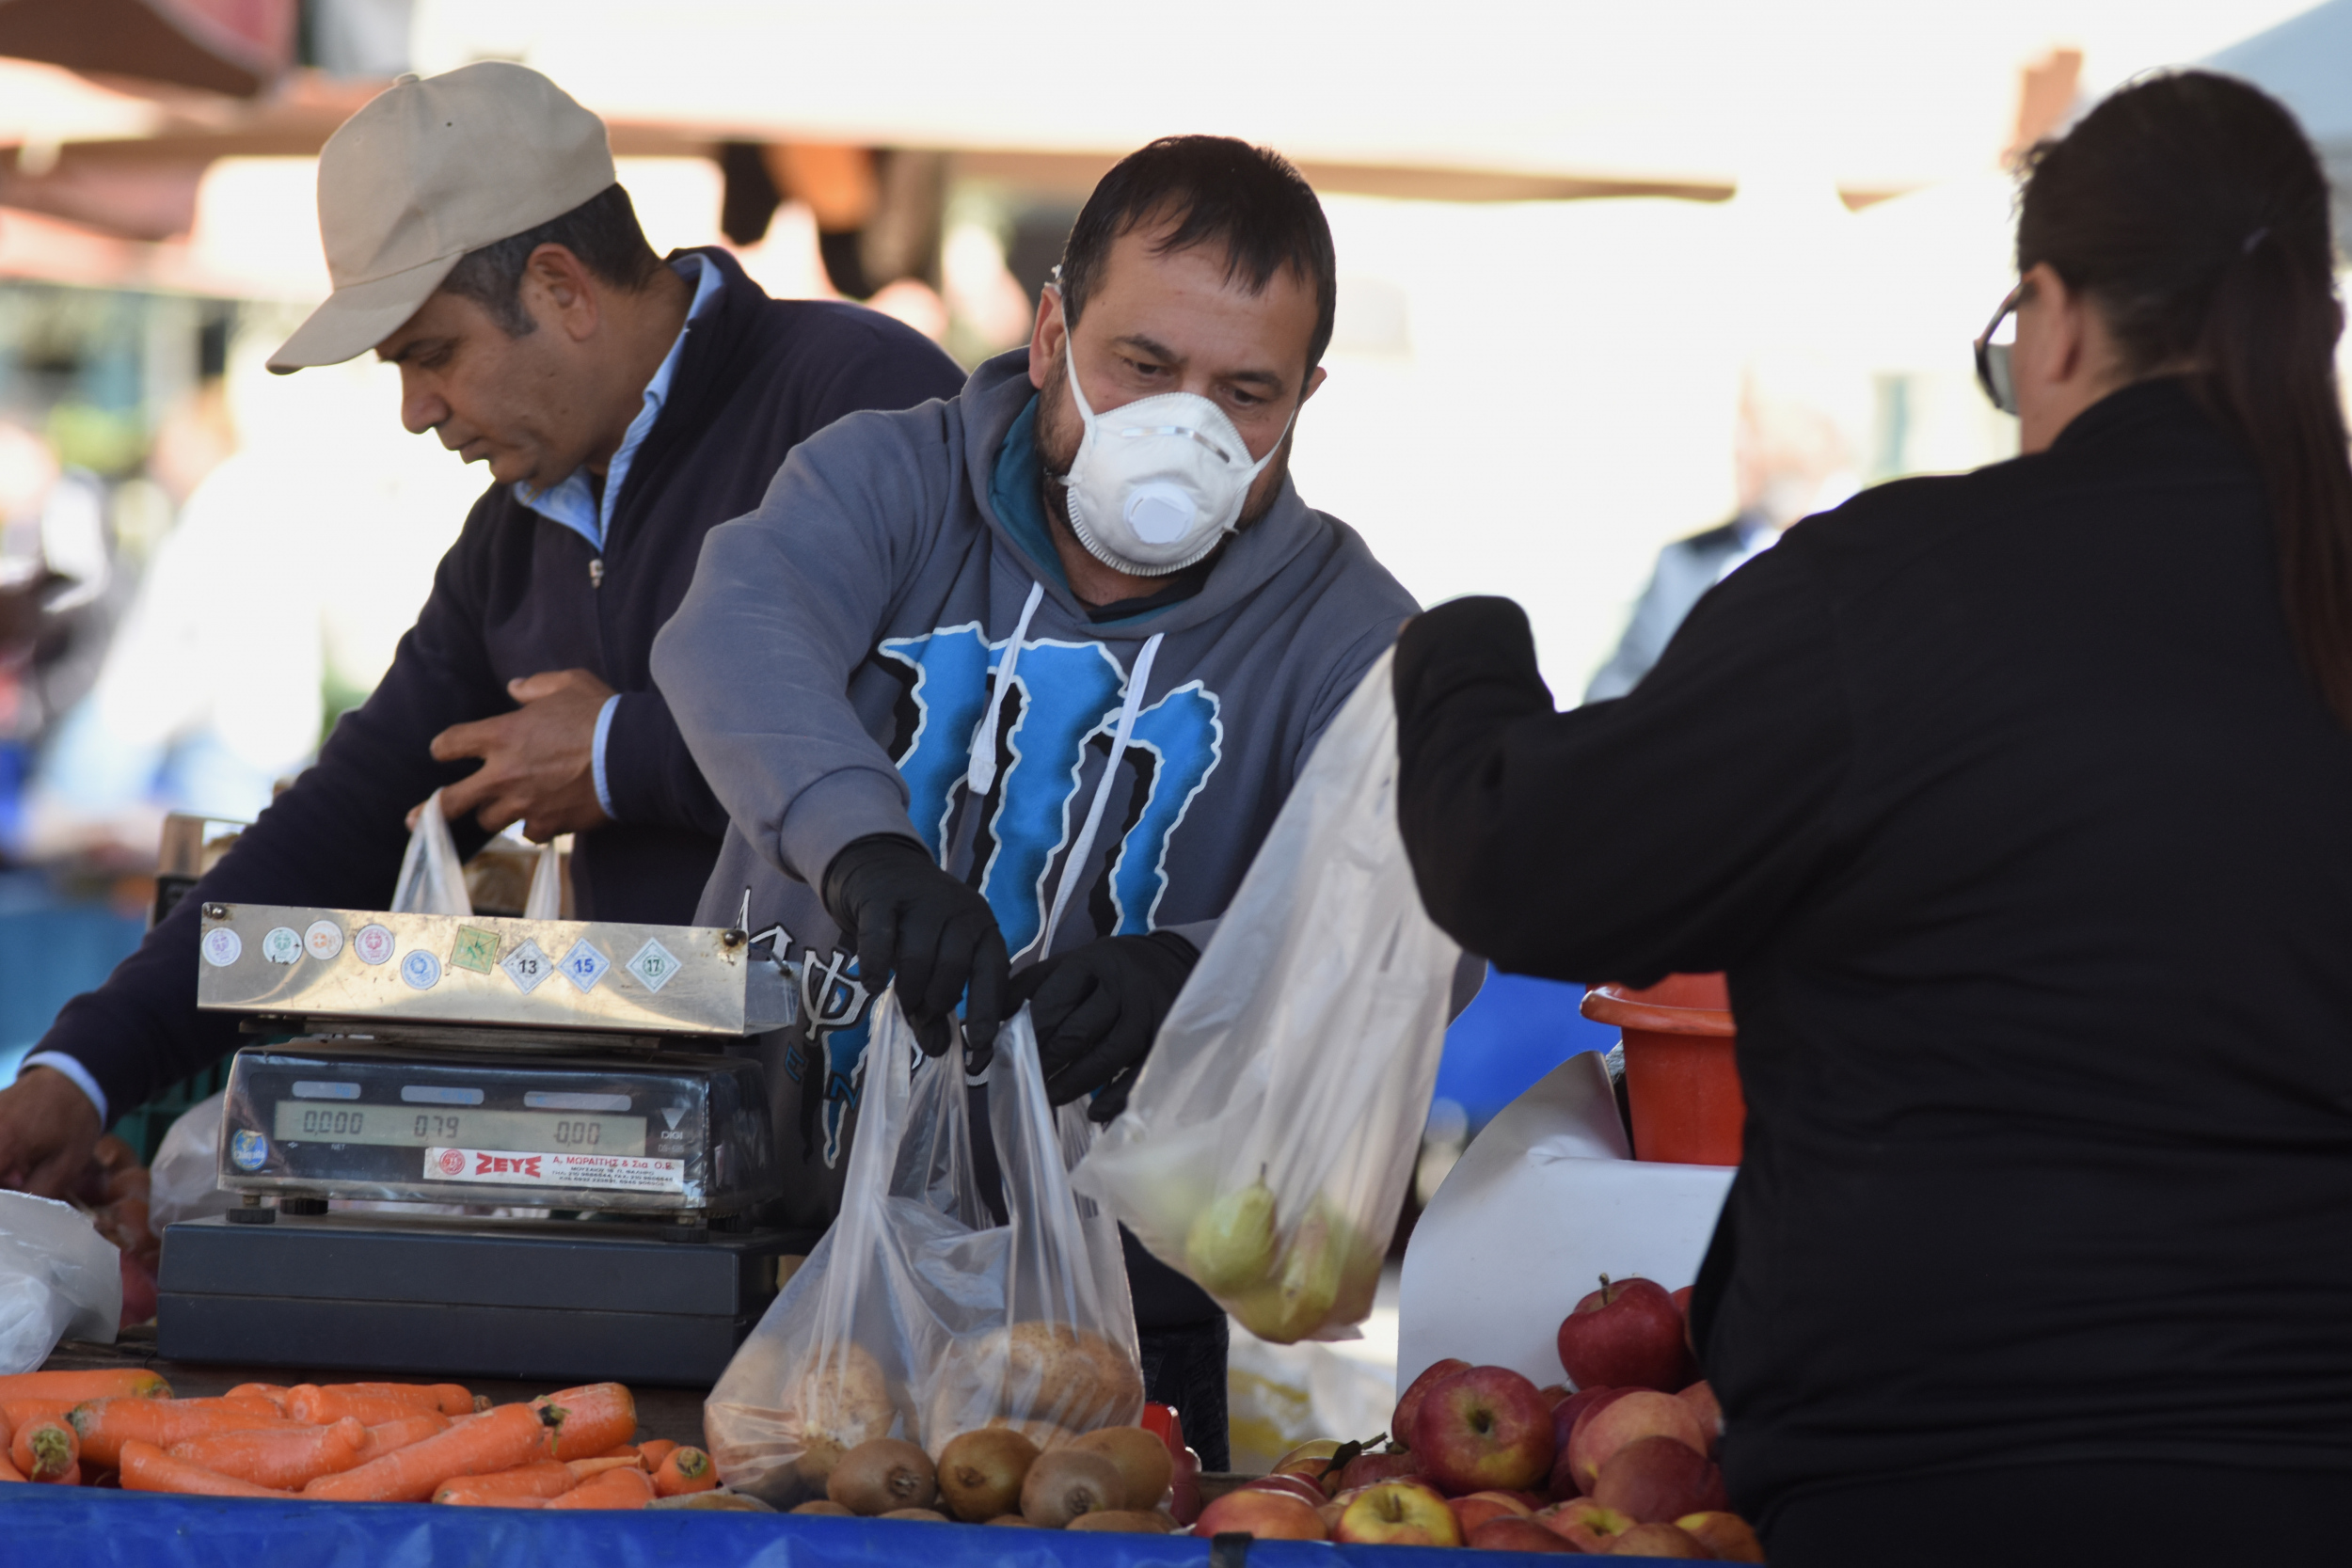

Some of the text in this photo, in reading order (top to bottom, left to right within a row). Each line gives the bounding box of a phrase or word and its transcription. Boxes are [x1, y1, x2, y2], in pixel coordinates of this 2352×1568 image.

[519, 959, 537, 974] 13
[575, 958, 595, 974] 15
[647, 959, 660, 973] 17
[335, 1084, 351, 1097] kg
[415, 1115, 459, 1141] 0,79
[660, 1131, 683, 1140] DIGI
